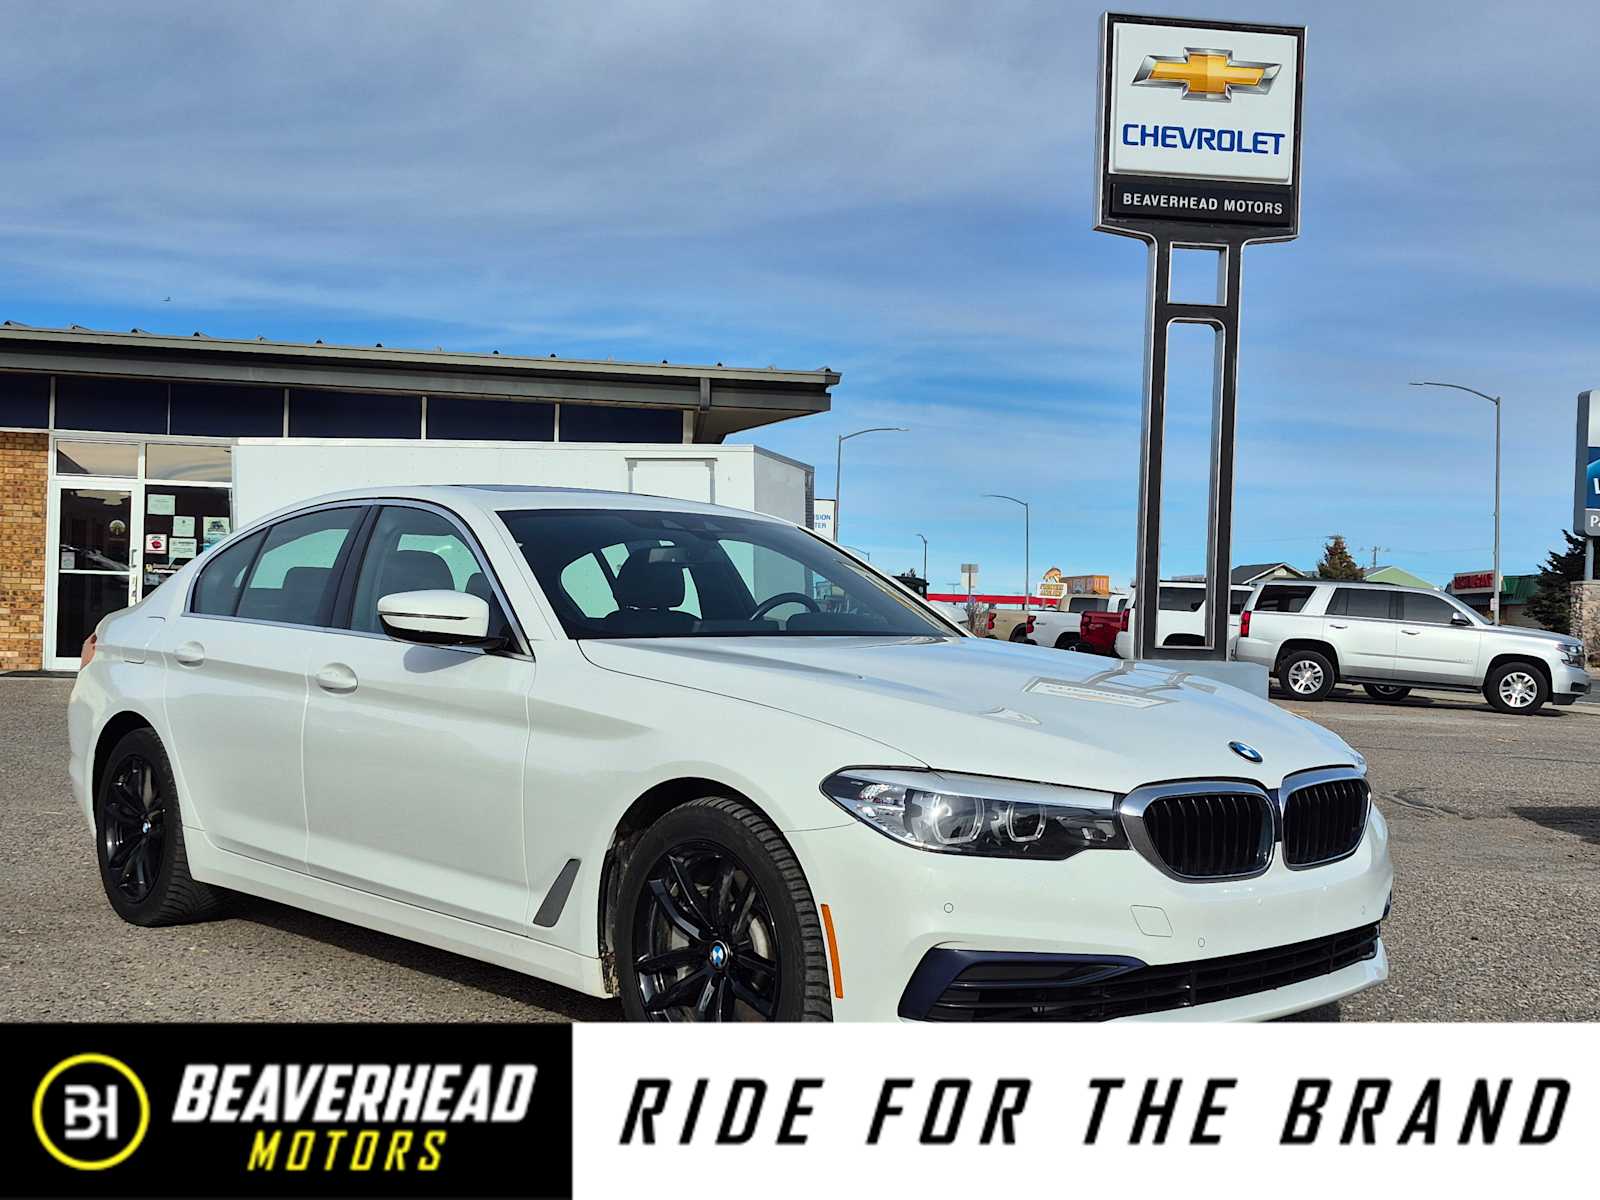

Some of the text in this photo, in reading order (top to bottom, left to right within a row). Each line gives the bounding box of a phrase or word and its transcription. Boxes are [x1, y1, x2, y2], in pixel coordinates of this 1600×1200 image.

[1123, 123, 1286, 155] CHEVROLET
[1123, 192, 1284, 215] BEAVERHEAD MOTORS
